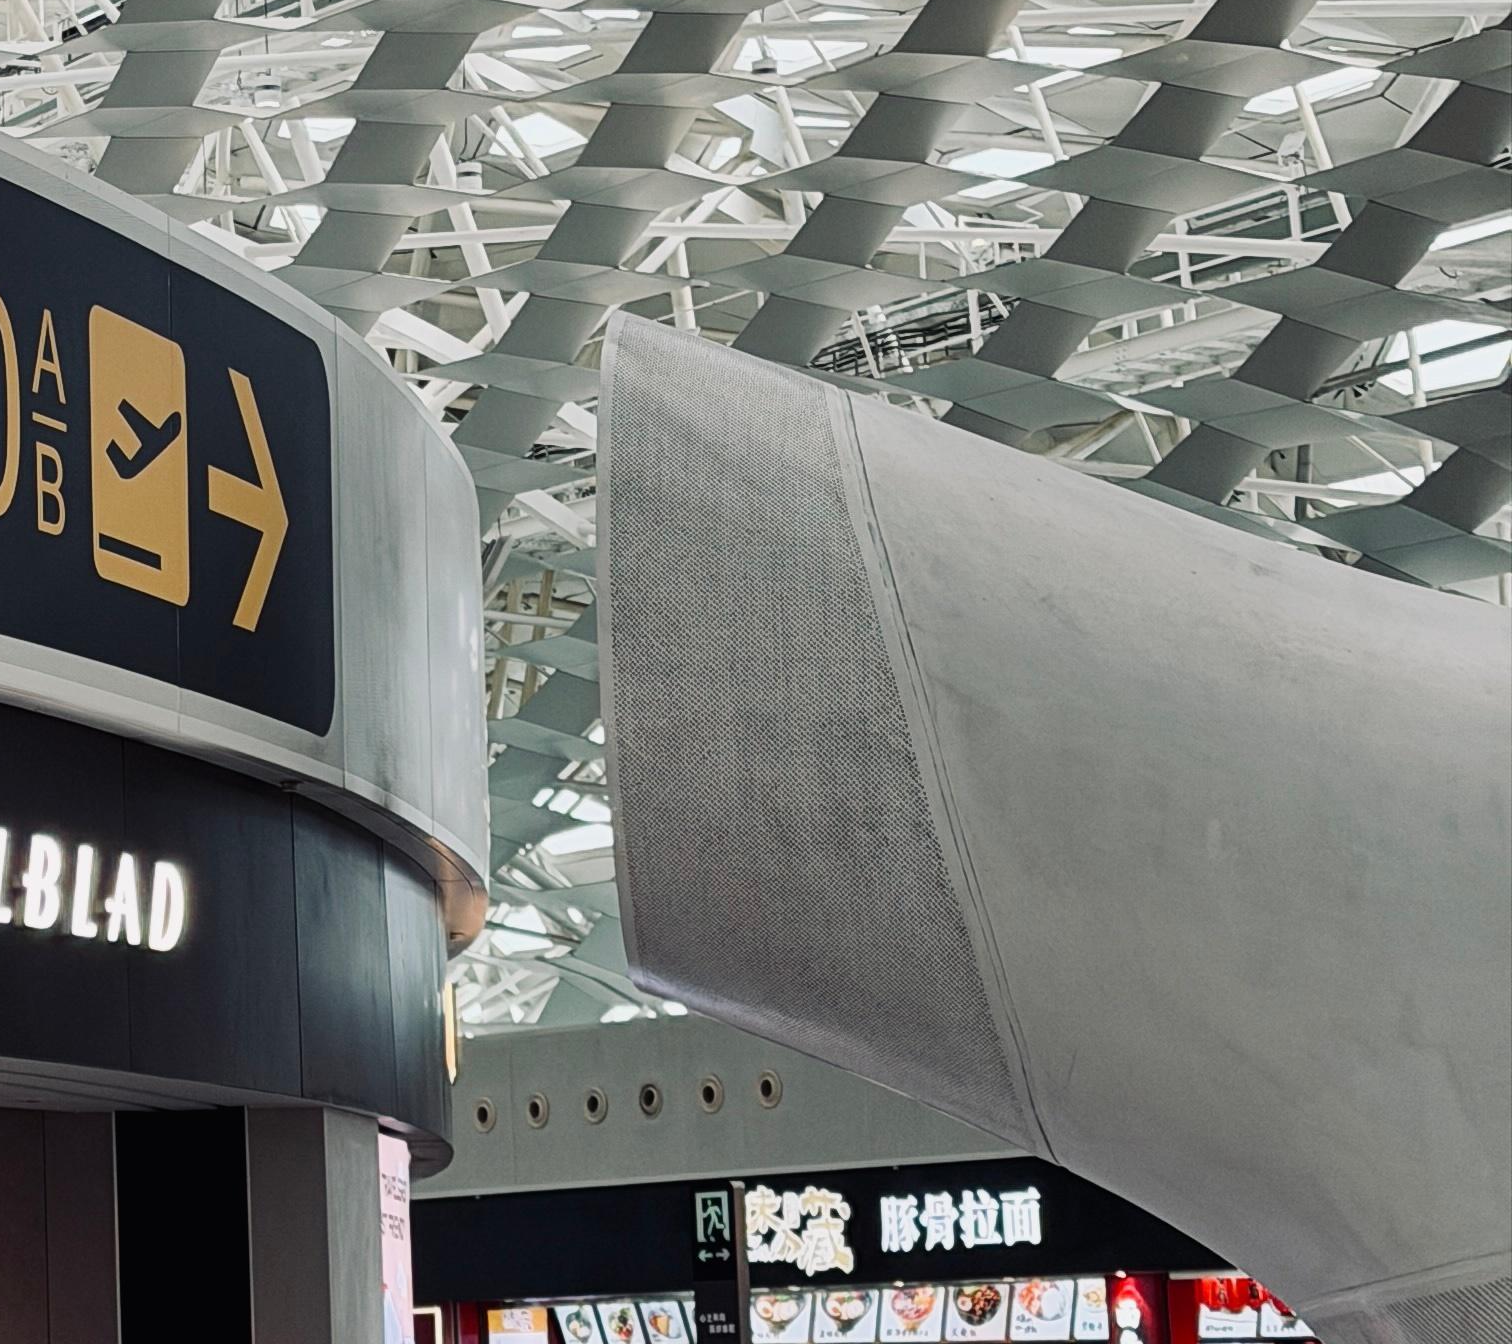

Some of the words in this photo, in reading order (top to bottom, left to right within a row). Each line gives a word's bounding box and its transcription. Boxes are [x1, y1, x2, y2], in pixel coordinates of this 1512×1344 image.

[32, 309, 66, 405] A
[35, 442, 65, 536] B
[880, 1187, 1042, 1253] 豚骨拉面
